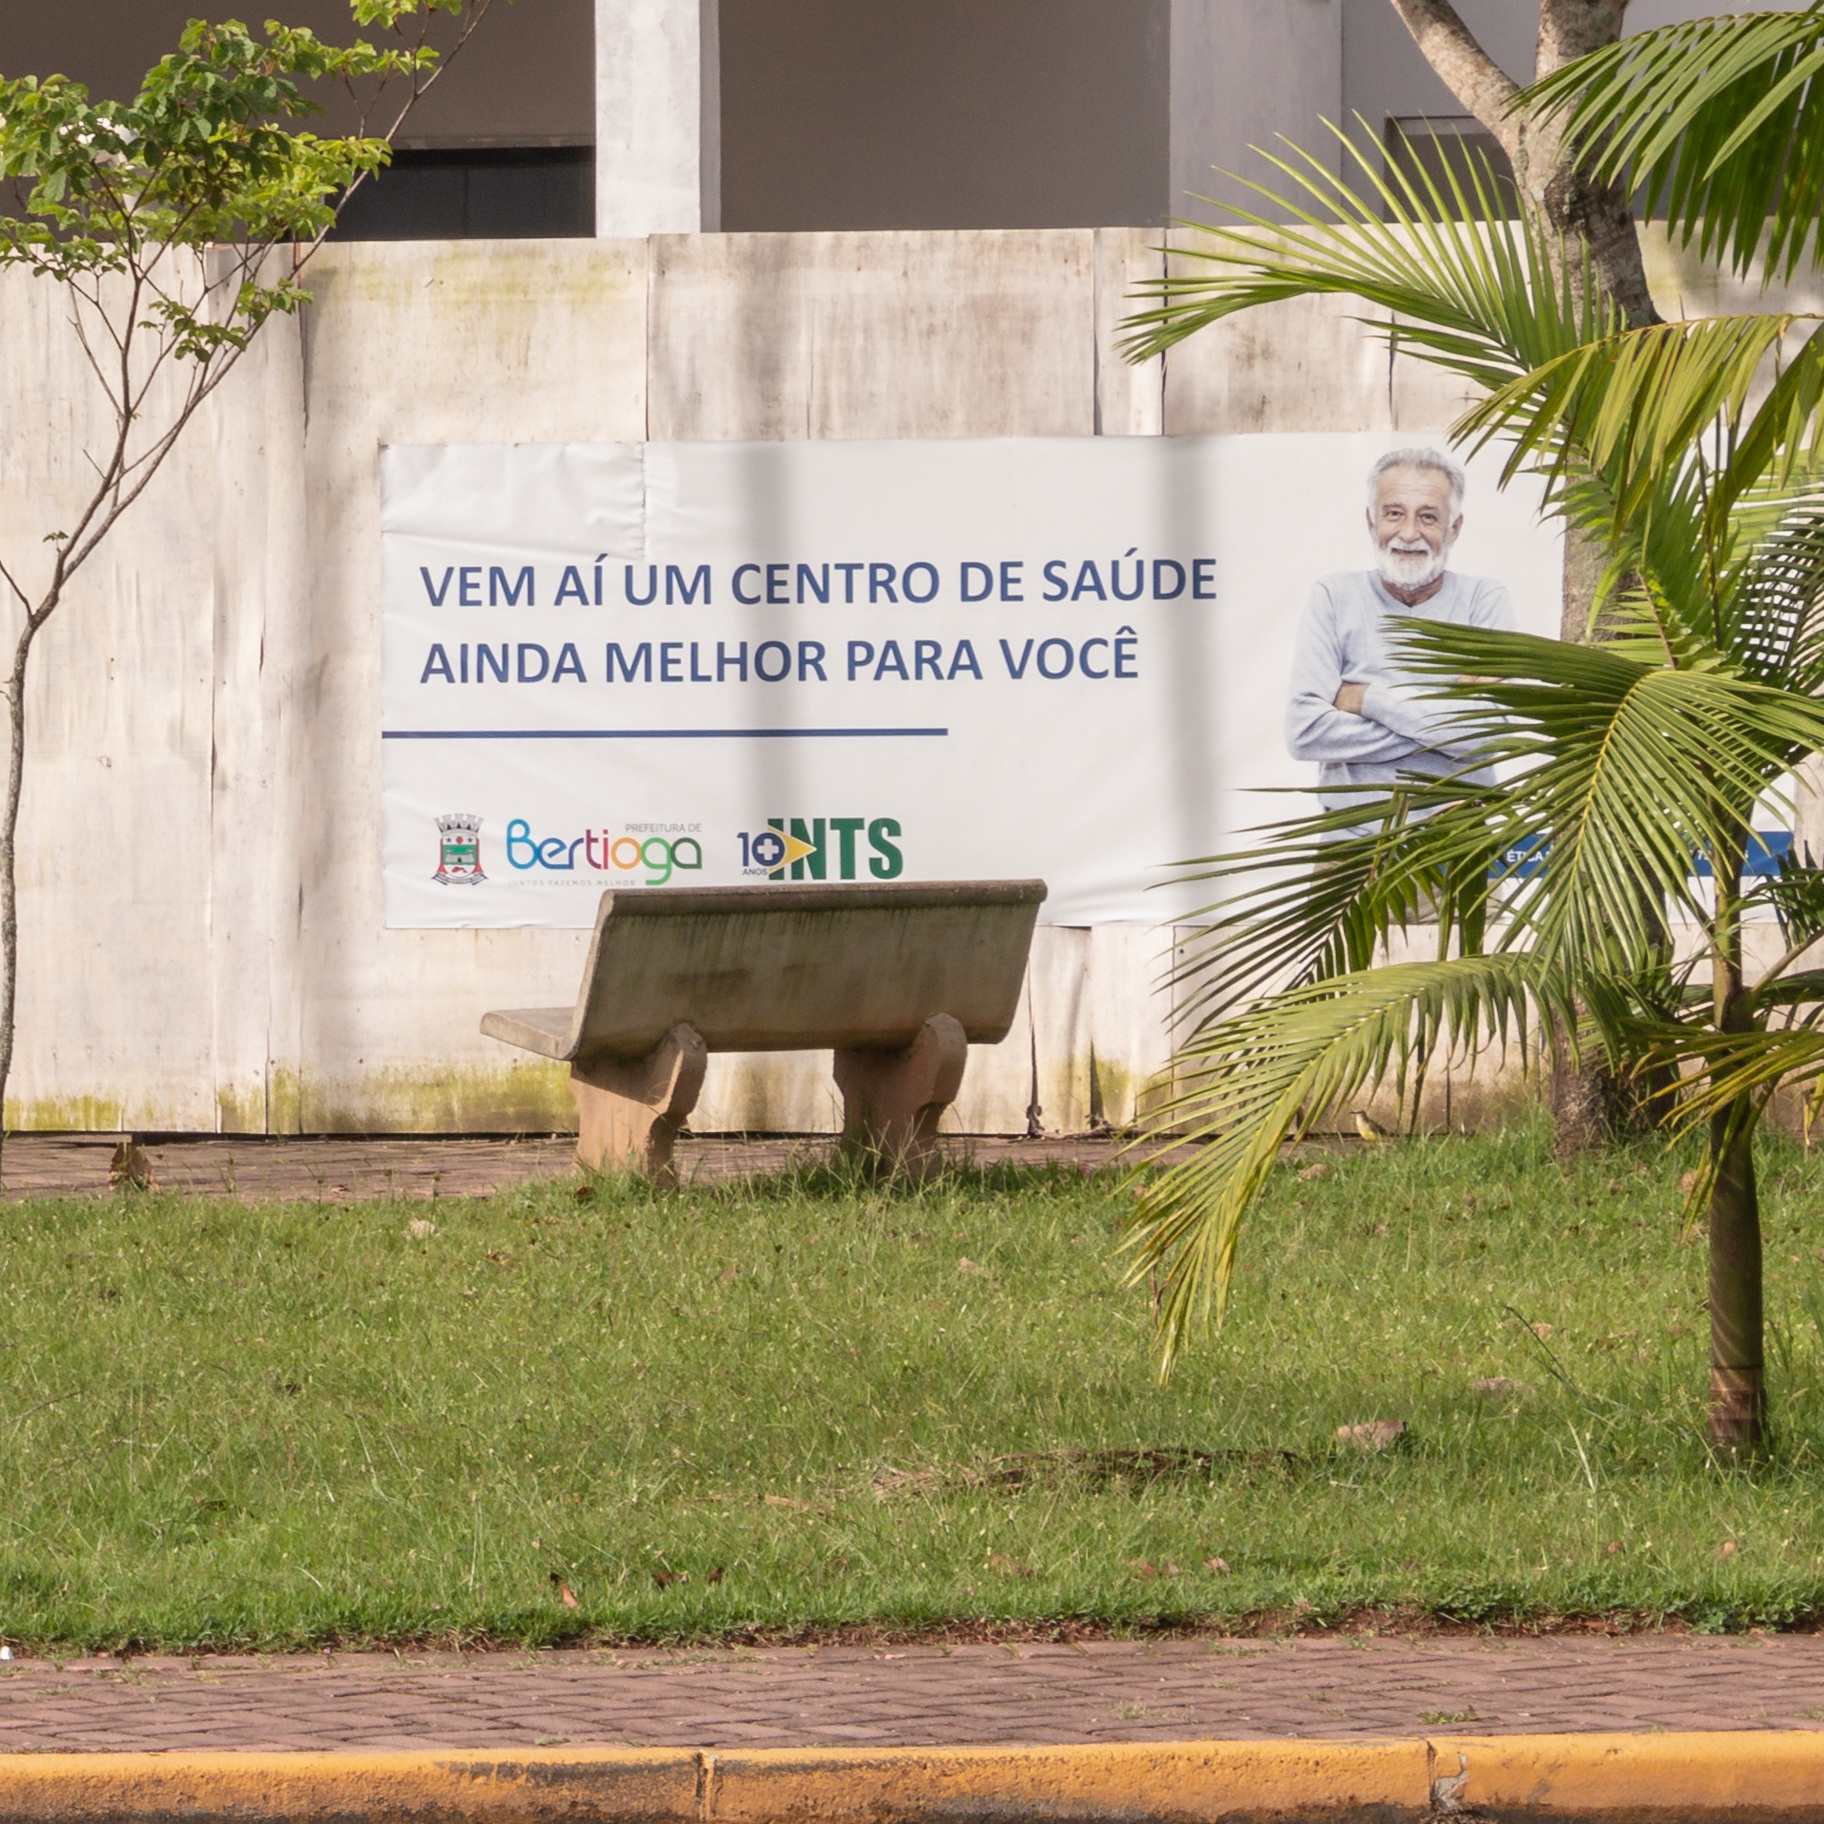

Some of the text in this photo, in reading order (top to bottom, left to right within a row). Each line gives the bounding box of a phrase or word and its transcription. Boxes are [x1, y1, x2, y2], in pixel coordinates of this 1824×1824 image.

[420, 548, 1217, 608] VEM AÍ UM CENTRO DE SAÚDE
[420, 626, 1139, 684] AINDA MELHOR PARA VOCÊ
[507, 819, 702, 886] Bertioga
[625, 823, 702, 833] PREFEITURA DE
[767, 818, 903, 880] INTS
